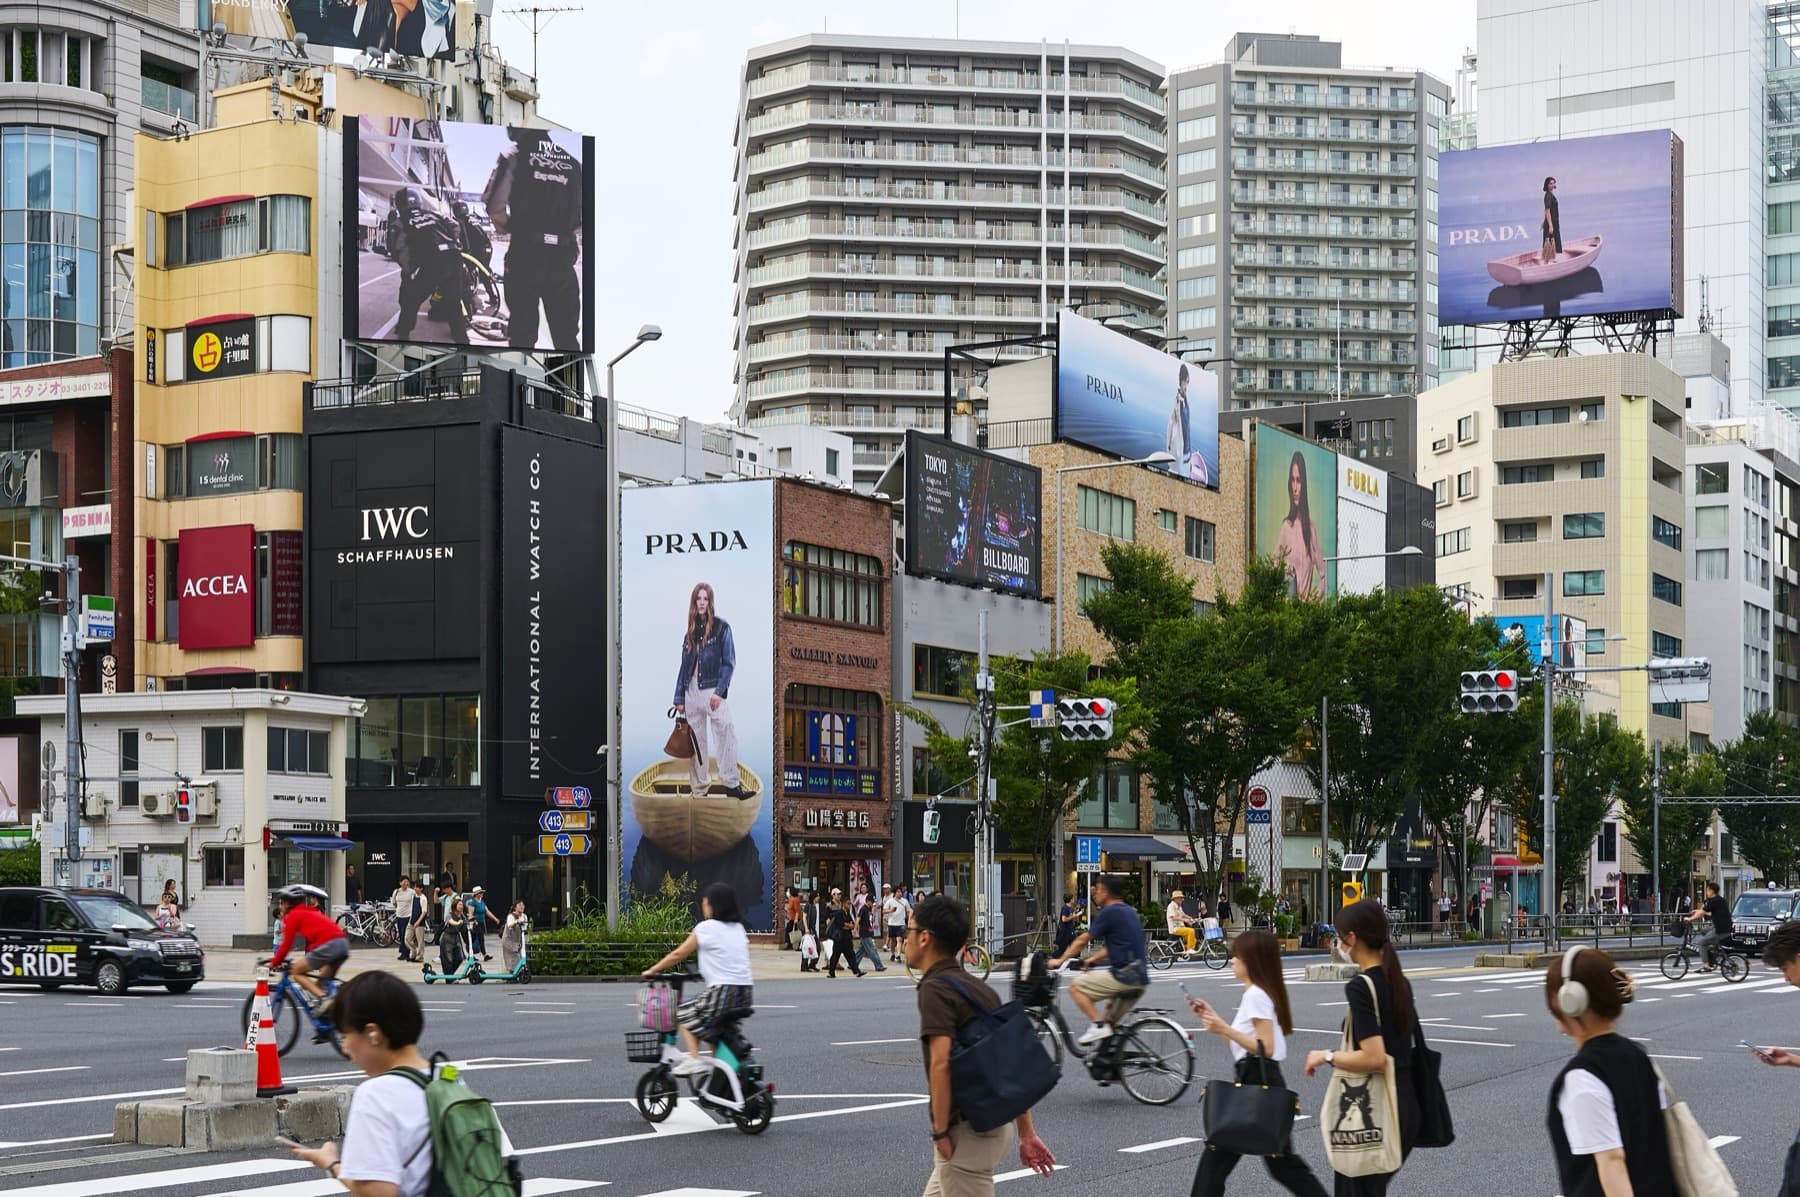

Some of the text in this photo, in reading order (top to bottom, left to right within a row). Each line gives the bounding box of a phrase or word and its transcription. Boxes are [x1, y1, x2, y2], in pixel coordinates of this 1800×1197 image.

[538, 140, 562, 153] IWC
[1449, 224, 1529, 247] PRADA
[199, 334, 218, 368] 占
[1086, 374, 1124, 404] PRADA
[924, 453, 948, 475] TOKYO
[1345, 467, 1379, 498] FURLA
[361, 505, 429, 541] IWC
[645, 529, 749, 556] PRADA
[337, 546, 454, 564] SCHAFFHAUSEN
[983, 547, 1030, 576] BILLBOARD
[147, 573, 155, 607] ACCEA
[182, 573, 248, 598] ACCEA
[88, 613, 113, 623] FamilyMart
[530, 452, 540, 779] INTERNATIONAL WATCH CO.
[791, 647, 833, 664] GALLERY
[548, 815, 562, 827] 413
[556, 838, 570, 850] 413
[371, 853, 386, 861] IWC
[1078, 863, 1100, 872] ここから
[1, 952, 78, 977] S.RIDE
[1330, 1128, 1382, 1145] WANTED
